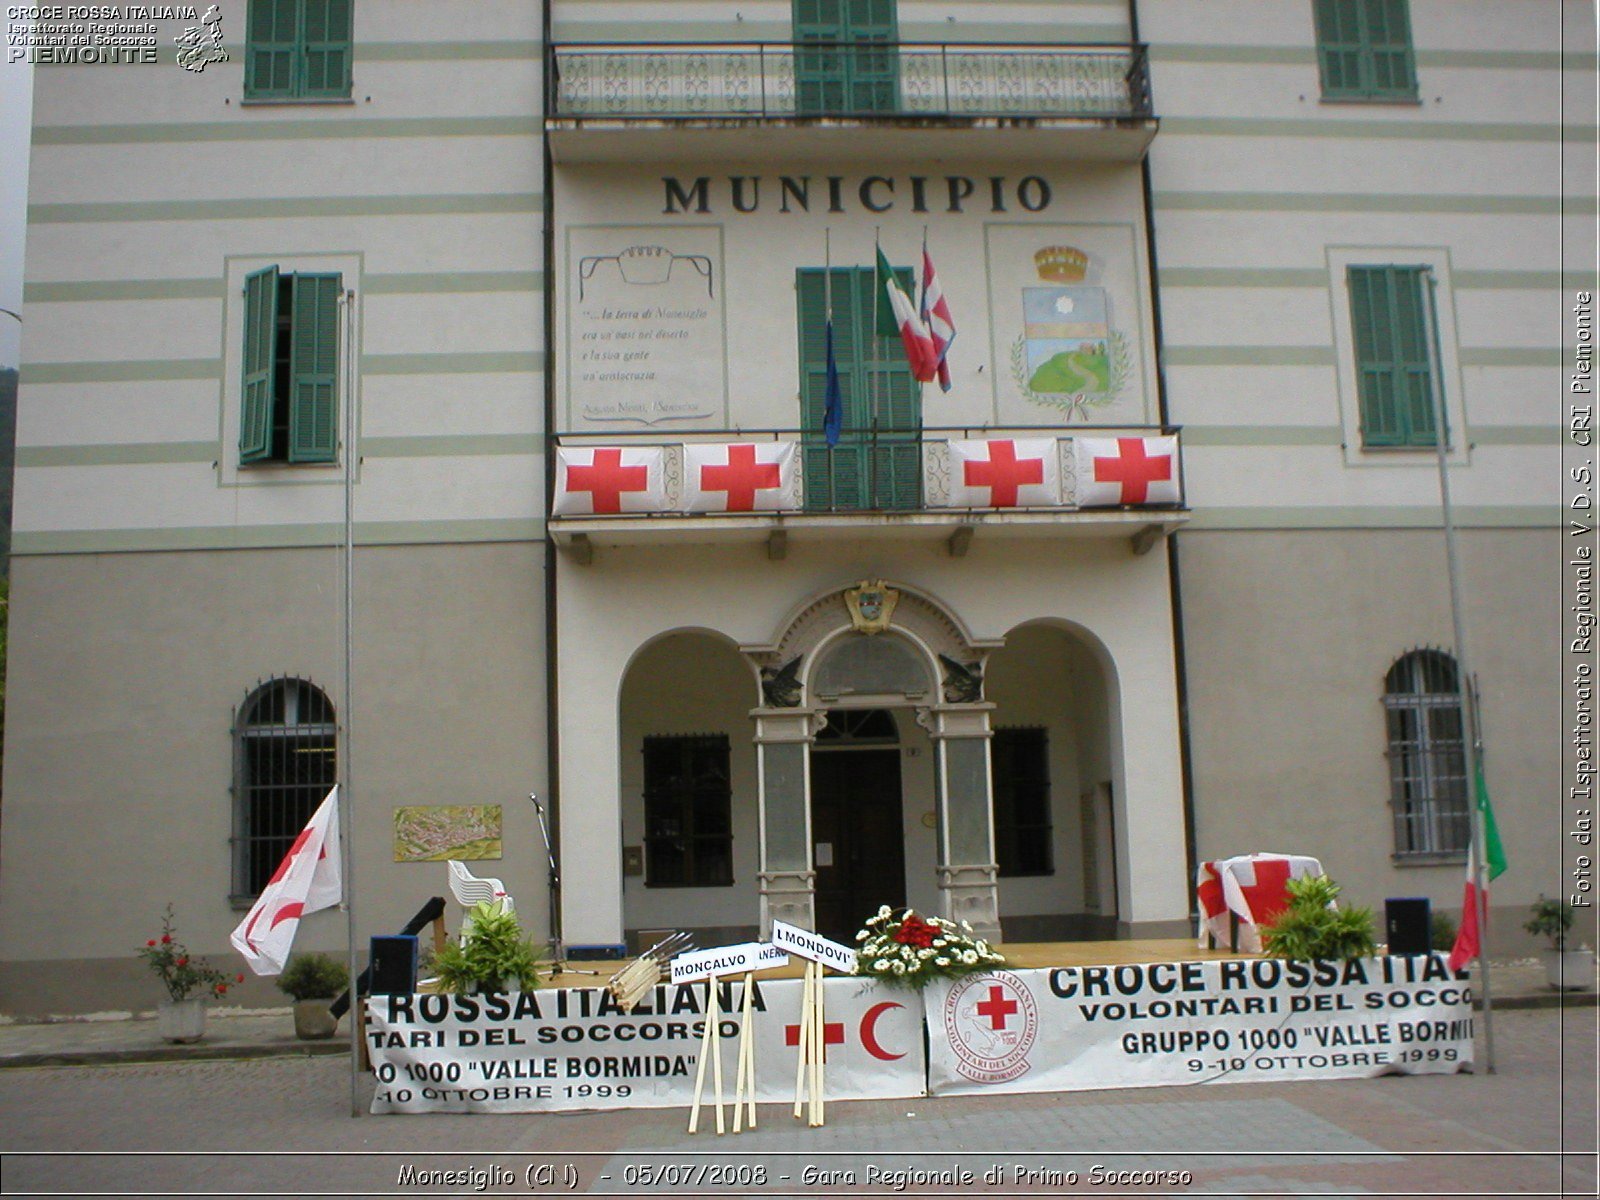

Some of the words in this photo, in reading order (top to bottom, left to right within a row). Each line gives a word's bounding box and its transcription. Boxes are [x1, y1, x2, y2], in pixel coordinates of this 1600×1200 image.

[661, 175, 1052, 213] MUNICIPIO
[616, 309, 639, 320] terra
[642, 308, 652, 320] di
[656, 329, 689, 340] deserto
[582, 352, 588, 361] e
[590, 350, 600, 361] la
[602, 352, 620, 361] sua
[623, 350, 650, 362] gente
[785, 931, 851, 964] MONDOVI'
[674, 954, 746, 977] MONCALVO
[1050, 962, 1205, 999] CROCE
[1220, 956, 1369, 990] ROSSA
[388, 990, 543, 1024] ROSSA
[1079, 996, 1278, 1021] VOLONTARI
[1291, 994, 1354, 1012] DEL
[369, 1030, 445, 1049] TARI
[459, 1028, 526, 1046] DEL
[537, 1020, 740, 1044] SOCCORSO
[947, 1025, 987, 1069] VOLONTARI
[989, 1060, 1006, 1071] DEL
[1007, 1019, 1036, 1064] SOCCORSO
[1122, 1028, 1230, 1054] GRUPPO
[1238, 1028, 1297, 1050] 1000
[1304, 1024, 1391, 1047] "VALLE
[404, 1062, 461, 1083] 1000
[469, 1058, 557, 1080] "VALLE
[566, 1055, 696, 1078] BORMIDA"
[961, 1063, 987, 1081] VALLE
[988, 1062, 1027, 1082] BORMIDA
[1255, 1051, 1393, 1070] OTTOBRE
[1400, 1048, 1458, 1064] 1999
[422, 1085, 552, 1102] OTTOBRE
[562, 1084, 632, 1098] 1999
